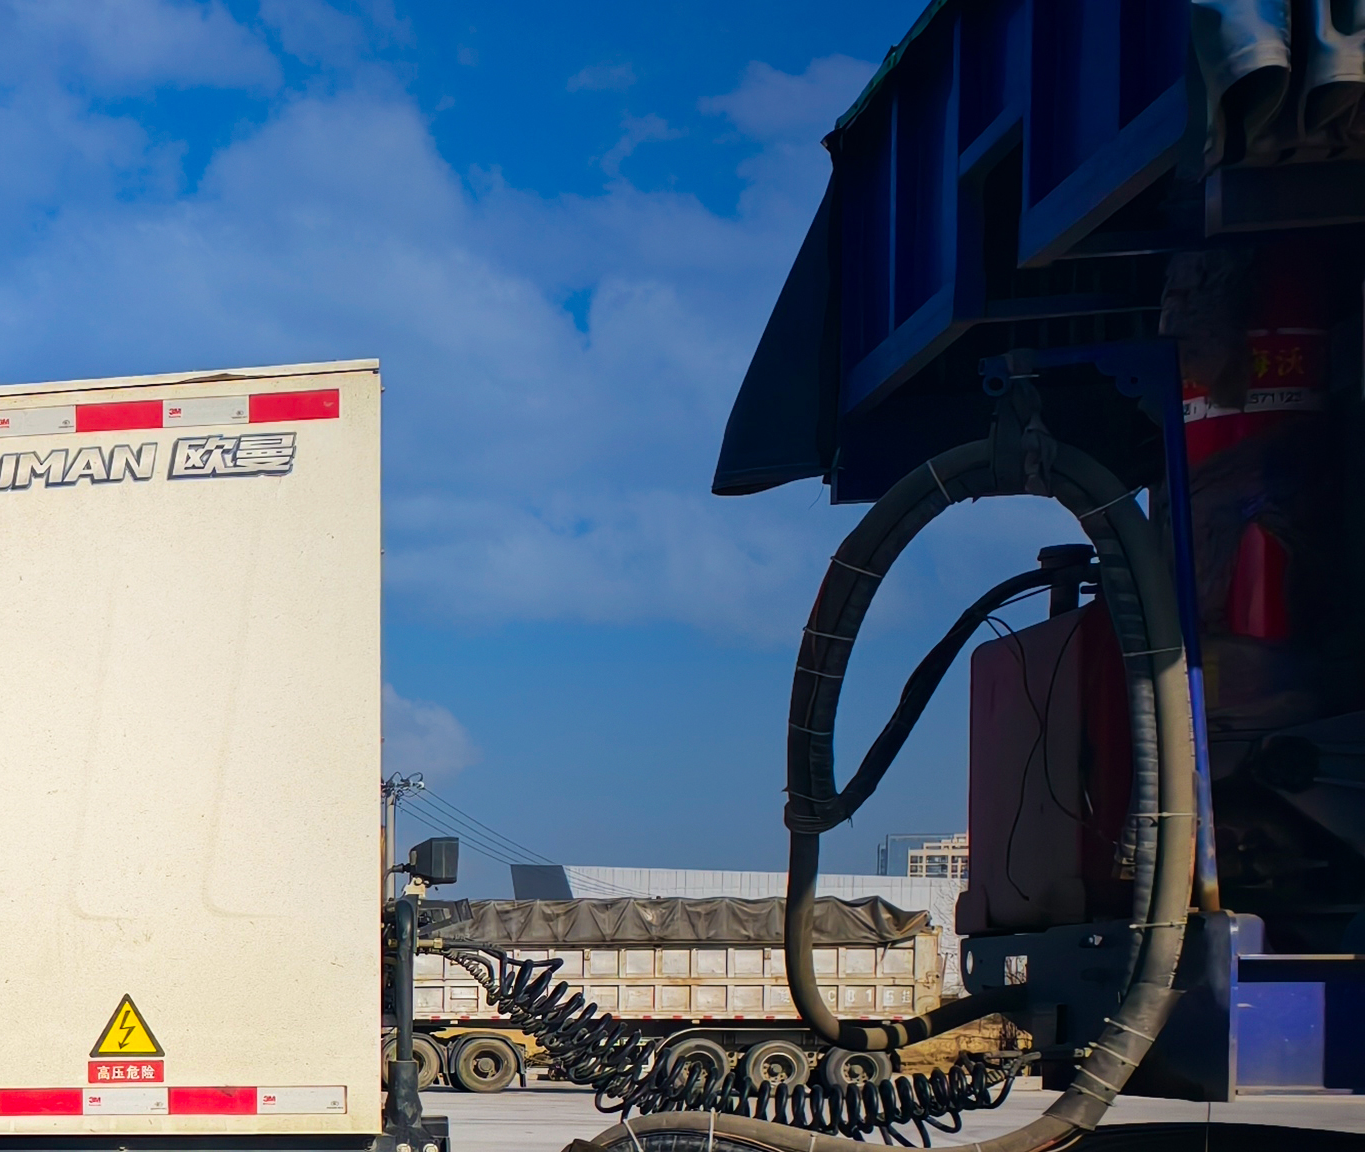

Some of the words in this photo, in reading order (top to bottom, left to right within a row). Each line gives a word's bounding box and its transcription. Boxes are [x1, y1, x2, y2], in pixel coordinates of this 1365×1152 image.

[167, 431, 297, 481] 欧曼
[96, 1065, 155, 1080] 高压危险
